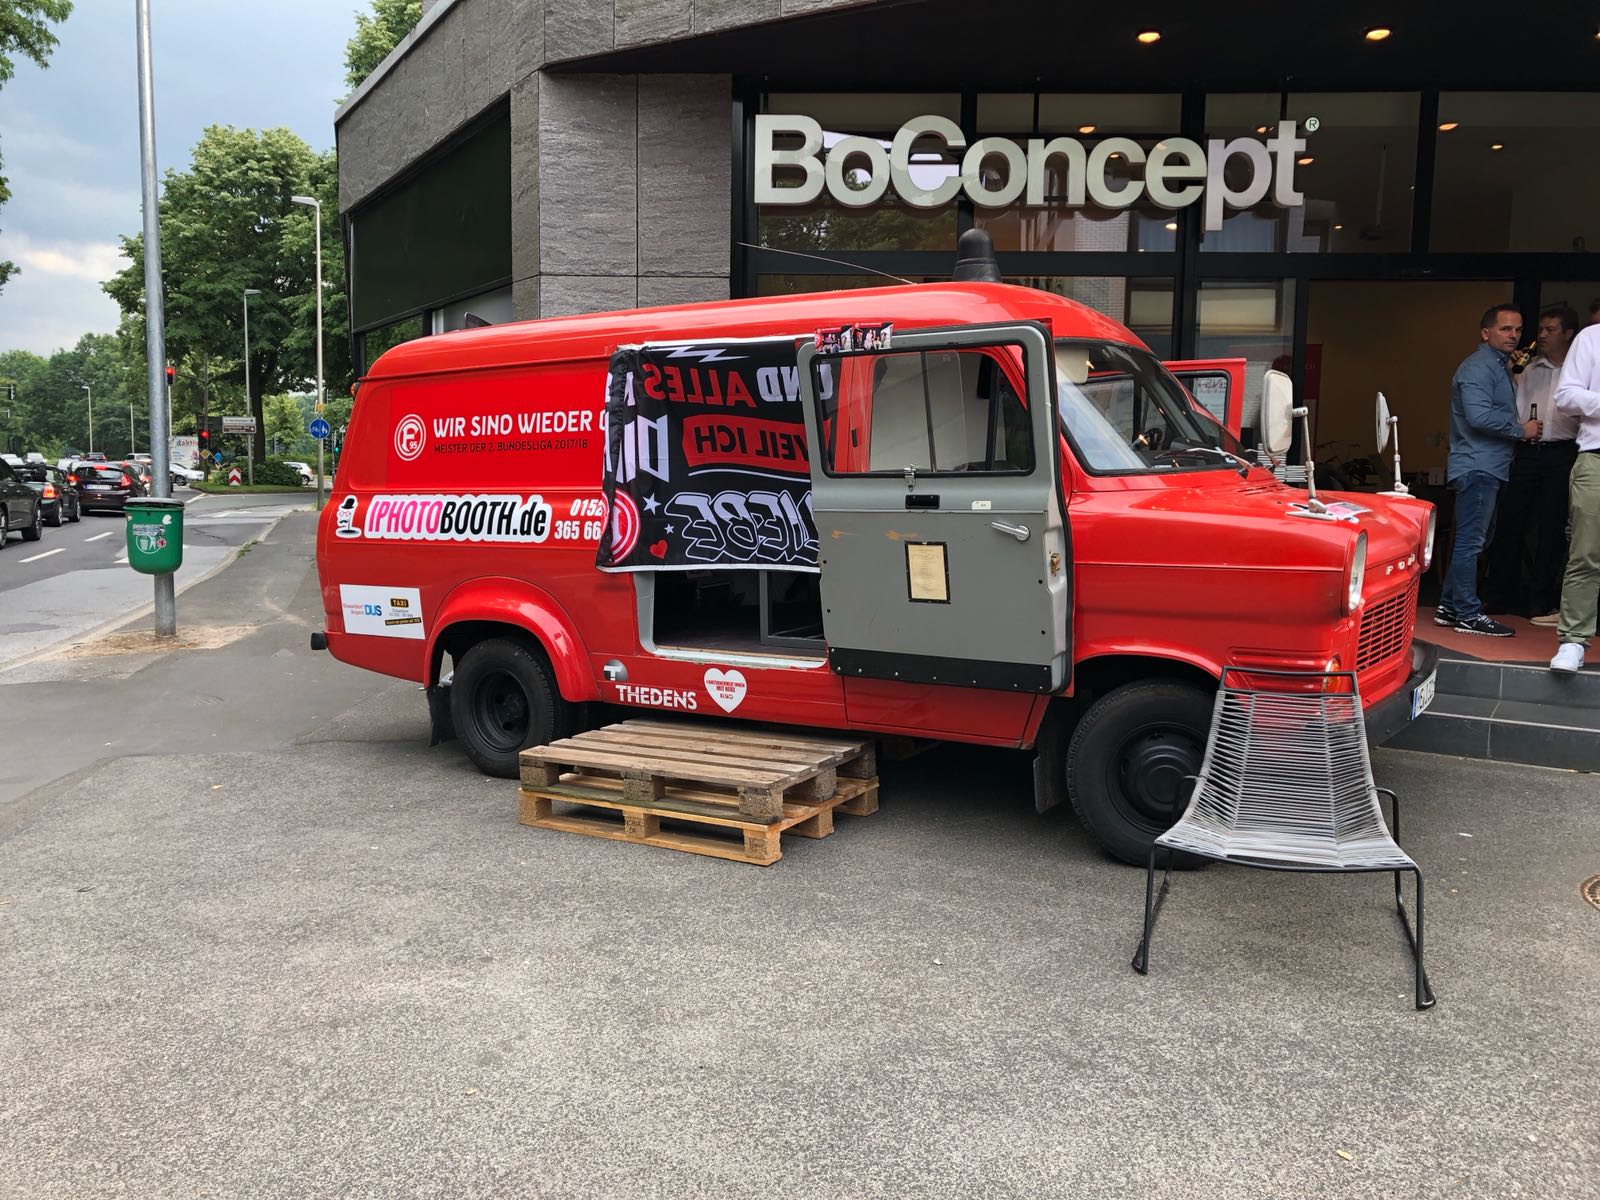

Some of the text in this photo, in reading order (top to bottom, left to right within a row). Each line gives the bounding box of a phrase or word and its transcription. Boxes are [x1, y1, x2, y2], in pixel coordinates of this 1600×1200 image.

[754, 114, 1307, 230] BoConcept
[433, 417, 466, 438] WIR
[470, 414, 513, 437] SIND
[518, 410, 593, 434] WIEDER
[433, 443, 467, 454] MEISTER
[470, 442, 486, 453] DER
[497, 440, 552, 452] BUNDESLIGA
[555, 439, 588, 450] 2017/18
[368, 500, 548, 537] IPHOTOBOOTH.de
[554, 520, 580, 540] 365
[364, 604, 382, 617] DUS
[615, 684, 698, 710] THEDENS
